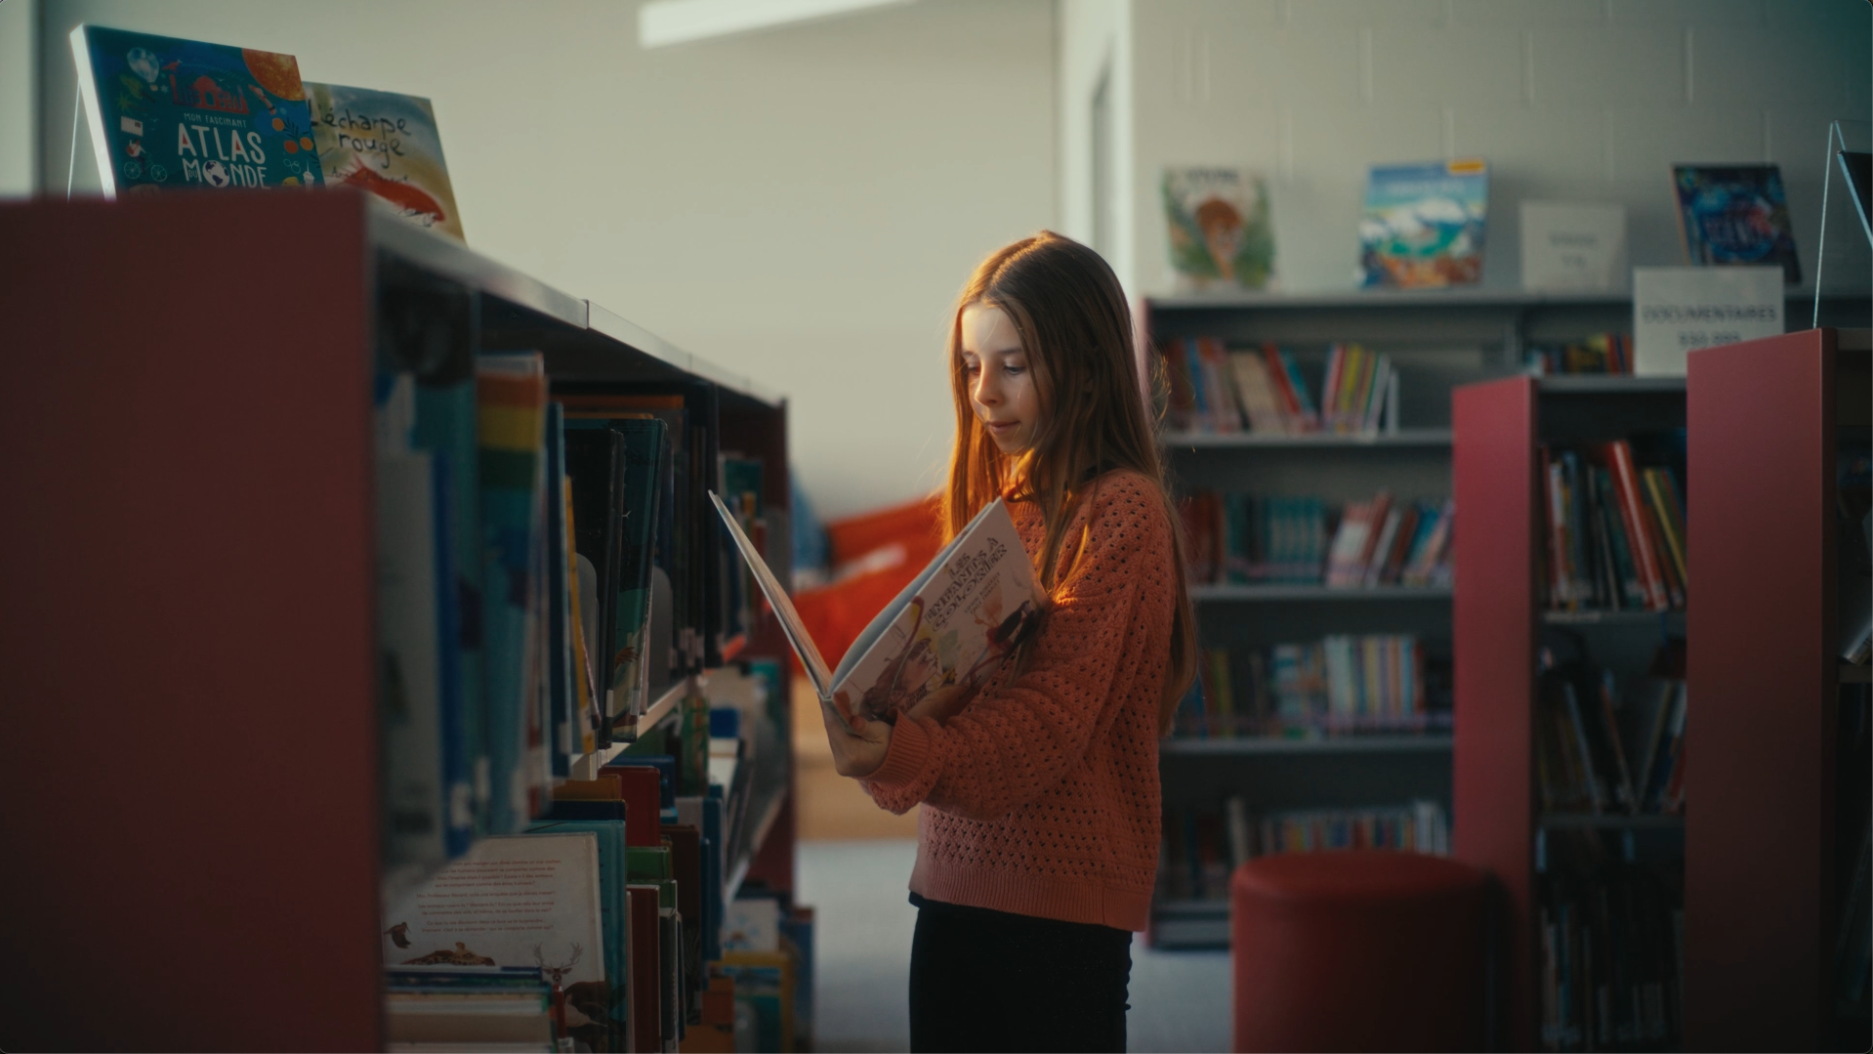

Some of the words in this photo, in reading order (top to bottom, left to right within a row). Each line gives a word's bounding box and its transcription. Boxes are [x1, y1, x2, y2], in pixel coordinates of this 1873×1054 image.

[183, 112, 202, 123] MON
[205, 114, 247, 129] FASCINANT
[178, 122, 266, 165] ATLAS
[338, 133, 405, 169] rouge
[924, 550, 987, 624] ENFANTS
[932, 544, 1007, 632] COLORIER
